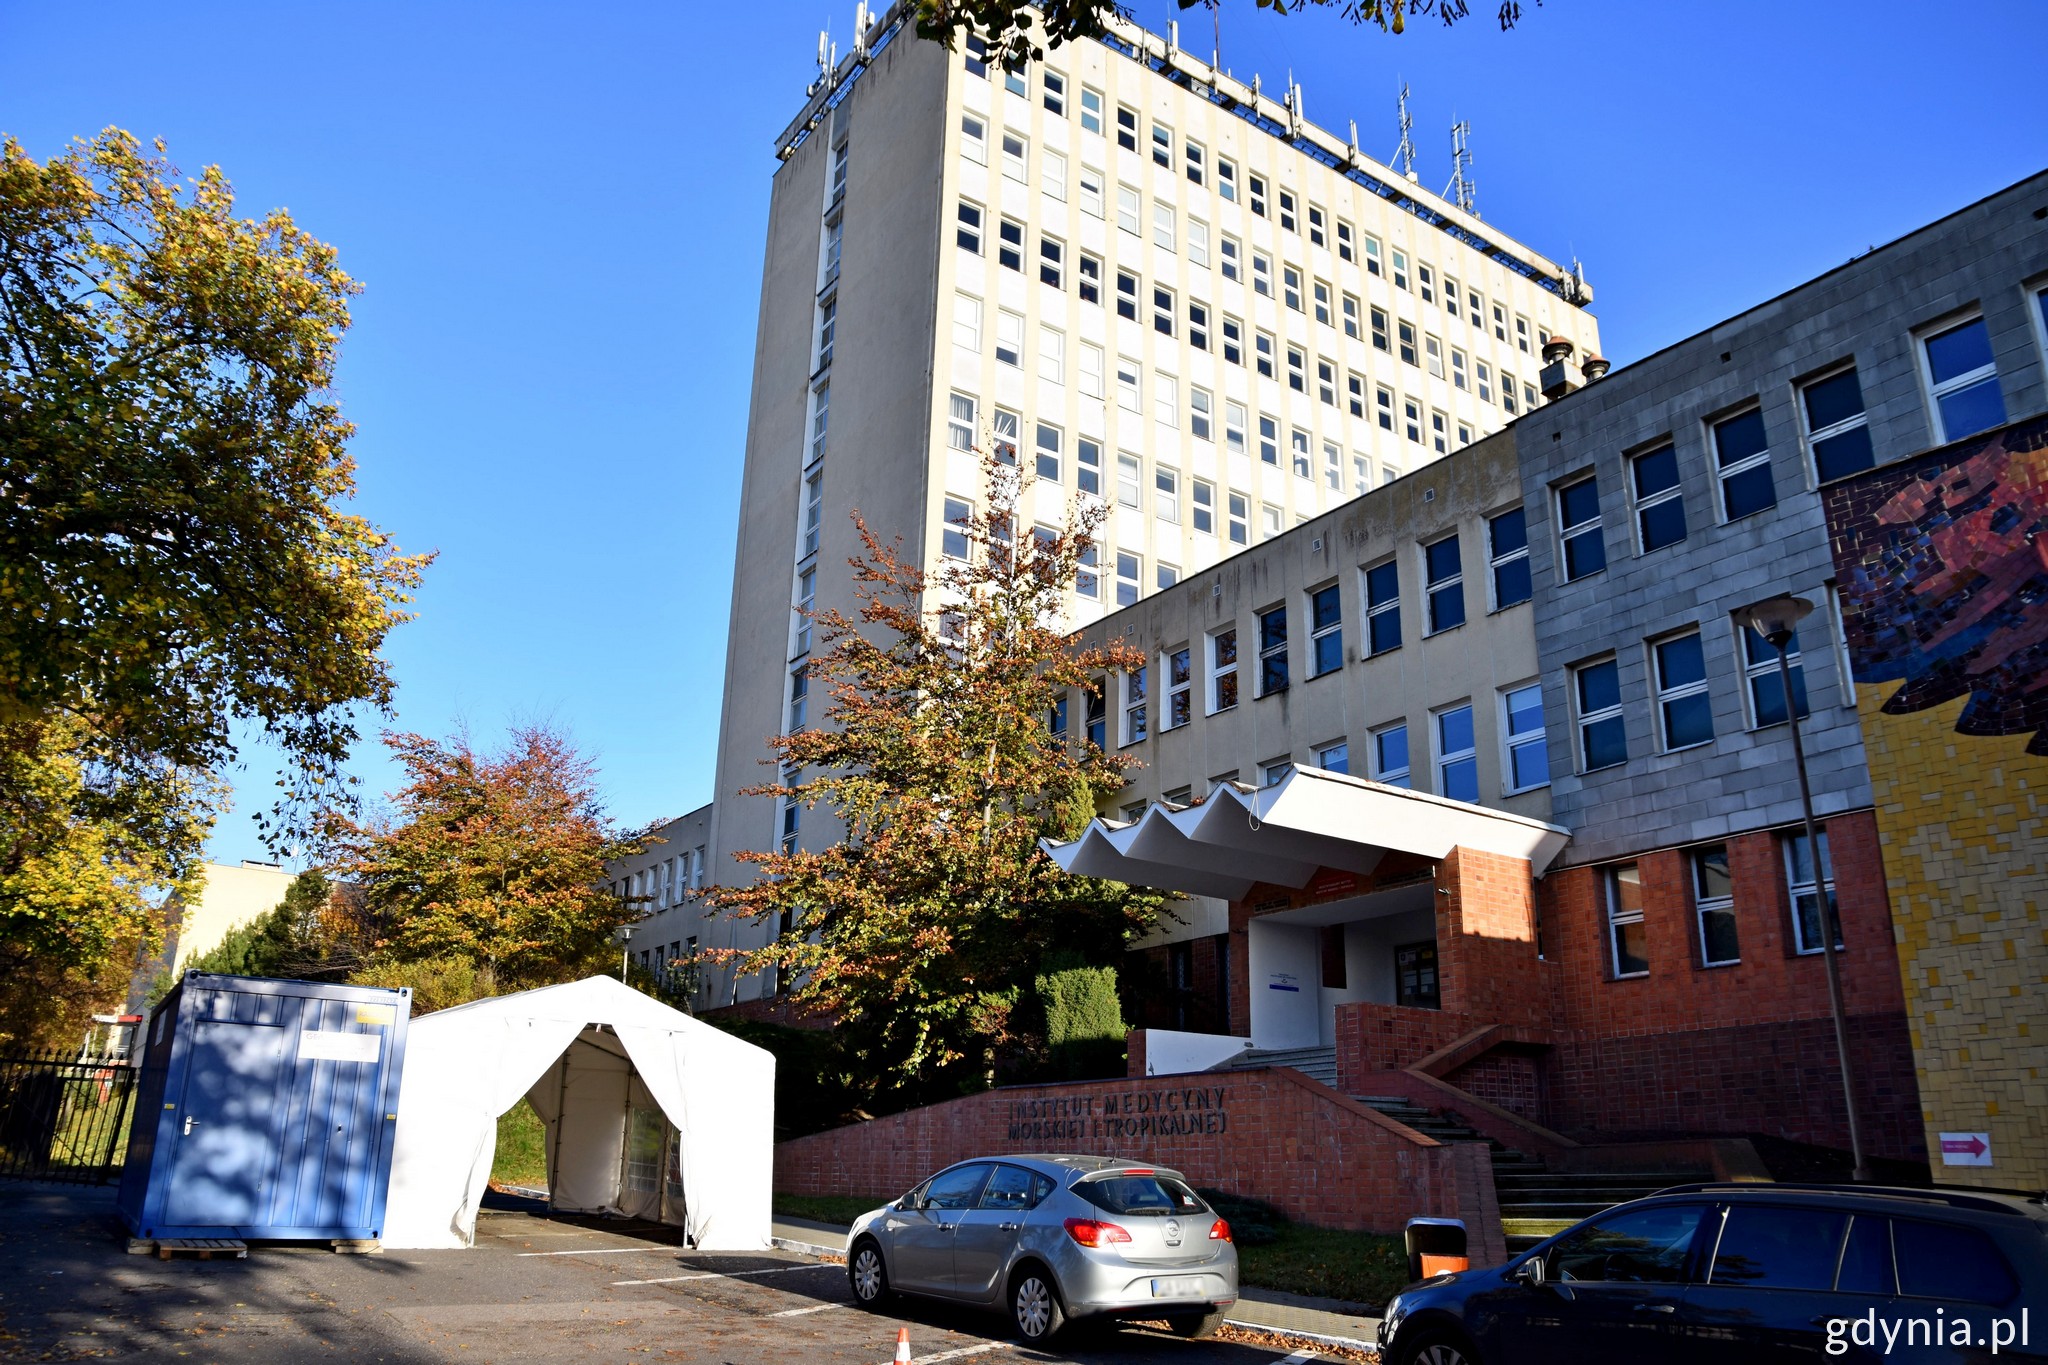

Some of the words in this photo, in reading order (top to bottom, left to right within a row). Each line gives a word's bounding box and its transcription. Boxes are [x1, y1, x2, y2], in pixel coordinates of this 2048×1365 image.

[1008, 1096, 1094, 1120] INSTYTUT
[1104, 1087, 1225, 1115] MEDYCYNY
[1008, 1119, 1085, 1140] MORSKIEJ
[1093, 1119, 1099, 1138] I
[1104, 1112, 1226, 1138] TROPIKALNEJ
